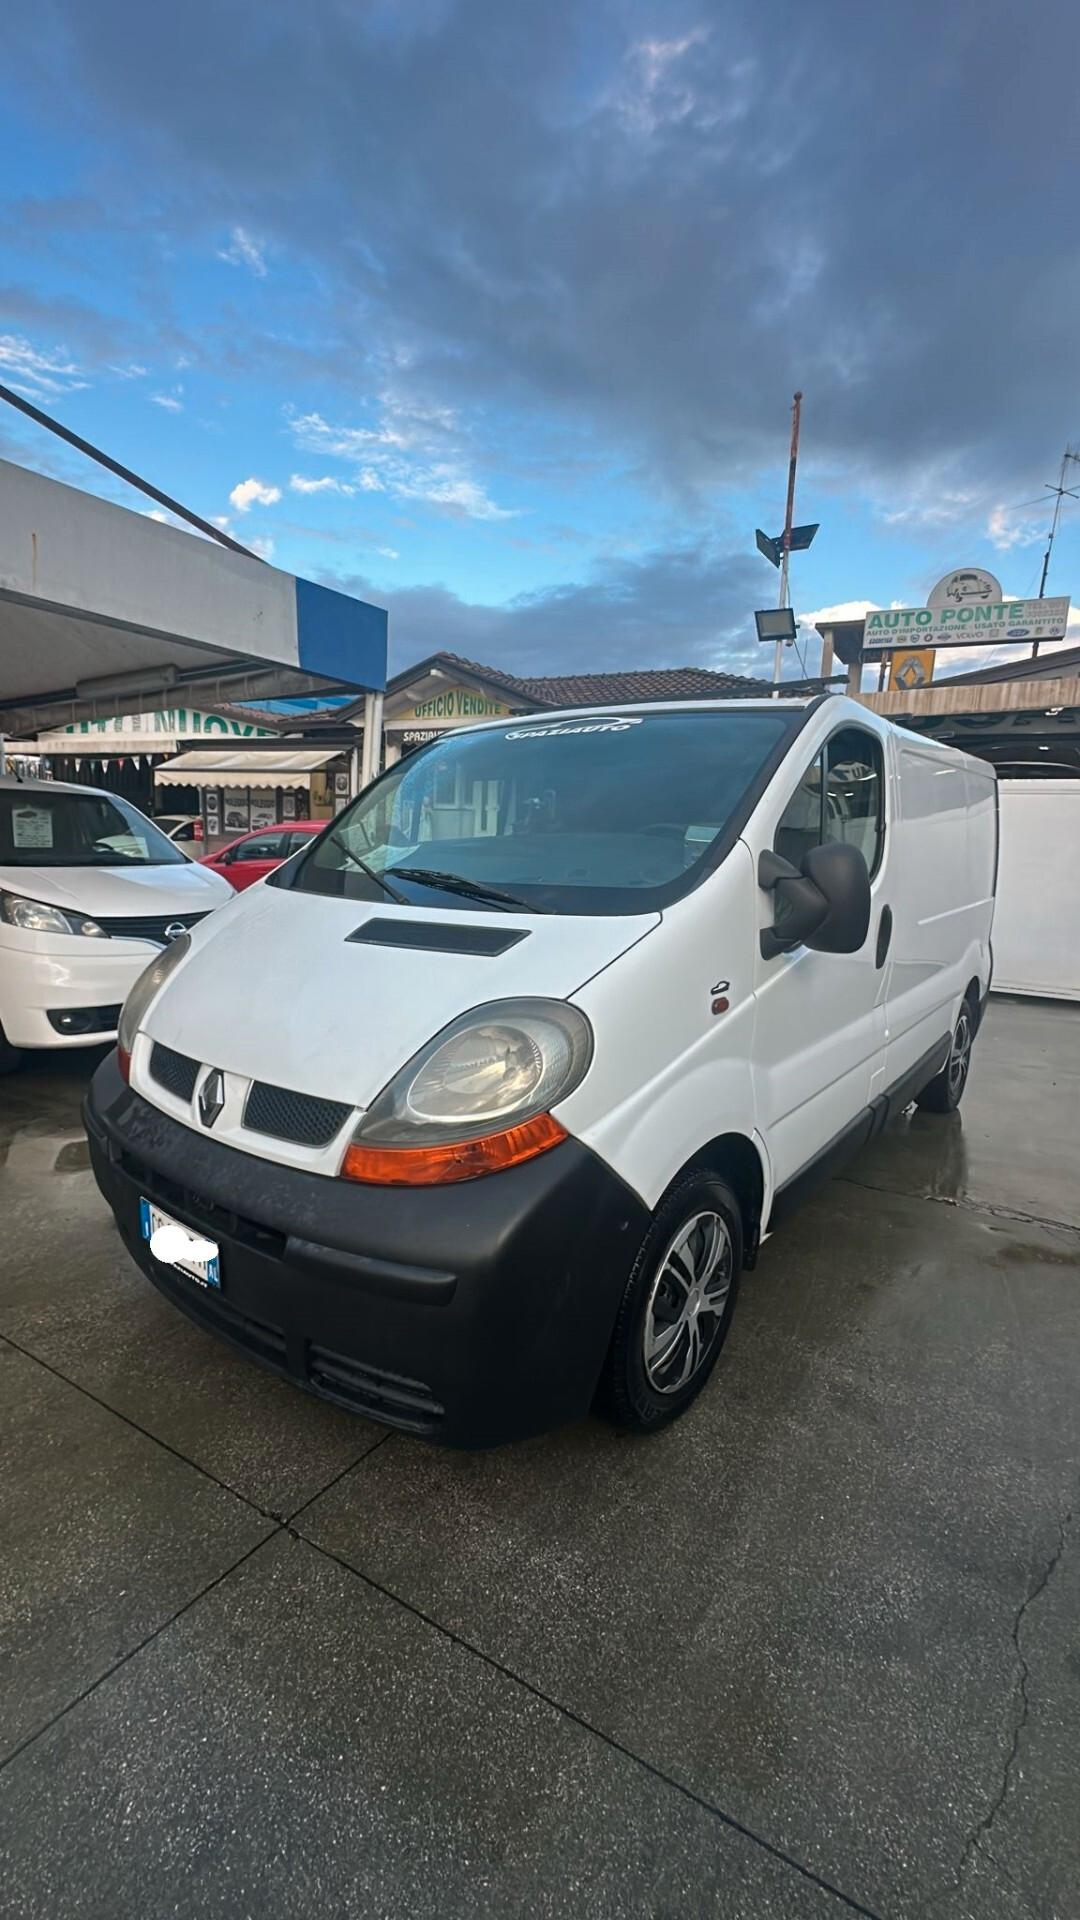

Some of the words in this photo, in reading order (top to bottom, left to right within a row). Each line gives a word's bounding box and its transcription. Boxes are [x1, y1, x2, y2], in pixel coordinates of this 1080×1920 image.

[868, 610, 932, 629] AUTO
[941, 603, 1025, 624] PONTE
[974, 621, 1006, 630] USATO
[1008, 617, 1064, 627] GARANTITO
[415, 691, 455, 717] UFFICIO
[456, 688, 502, 715] VENDITE
[504, 724, 631, 741] SPAZIAUTO
